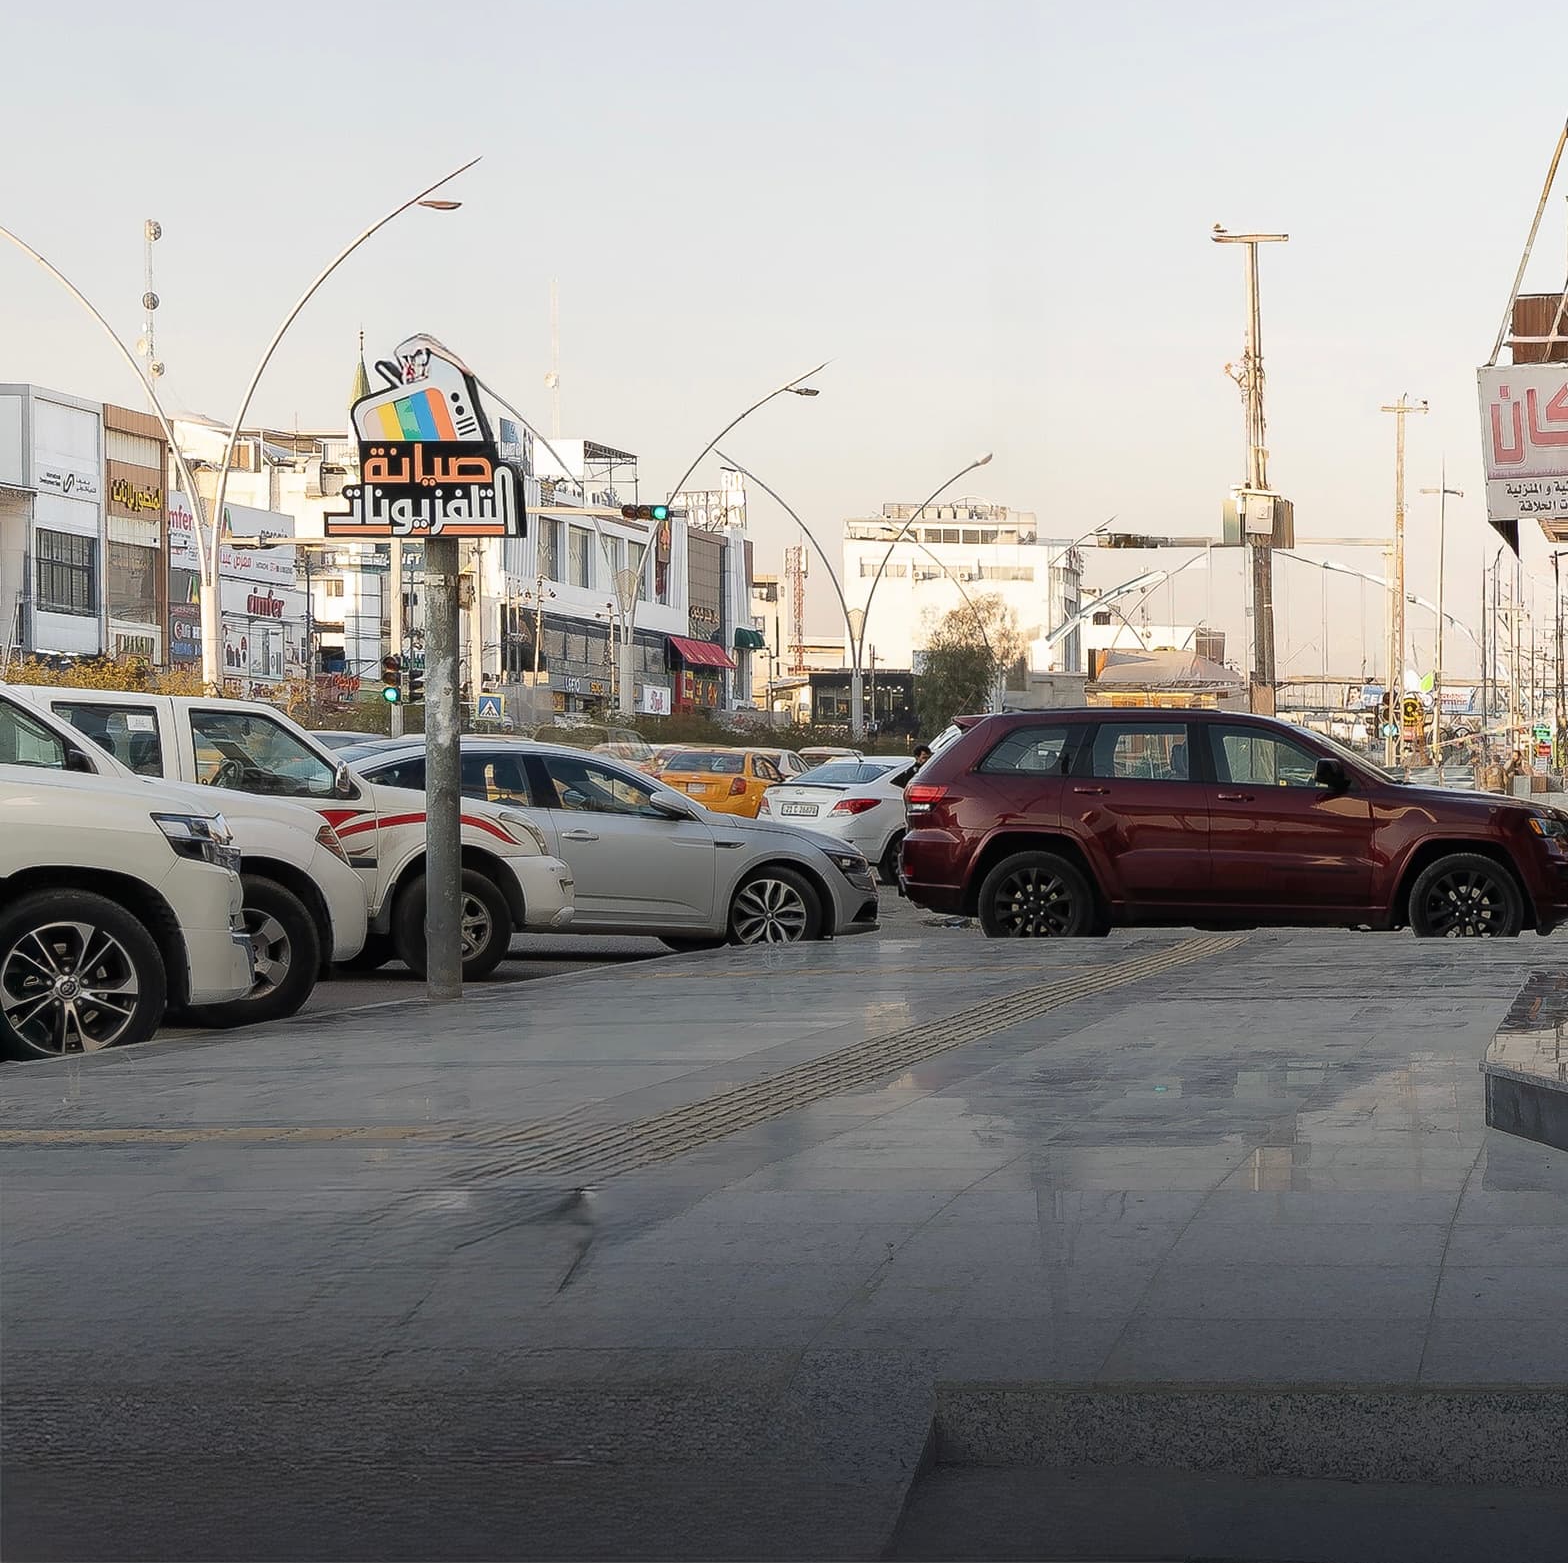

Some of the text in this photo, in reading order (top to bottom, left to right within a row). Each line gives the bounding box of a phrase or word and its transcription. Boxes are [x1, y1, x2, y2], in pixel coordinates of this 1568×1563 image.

[364, 442, 493, 487] صيانة
[328, 466, 517, 535] التلفزيونات
[1506, 480, 1543, 497] المنزلية
[1519, 499, 1556, 513] الحلاقة
